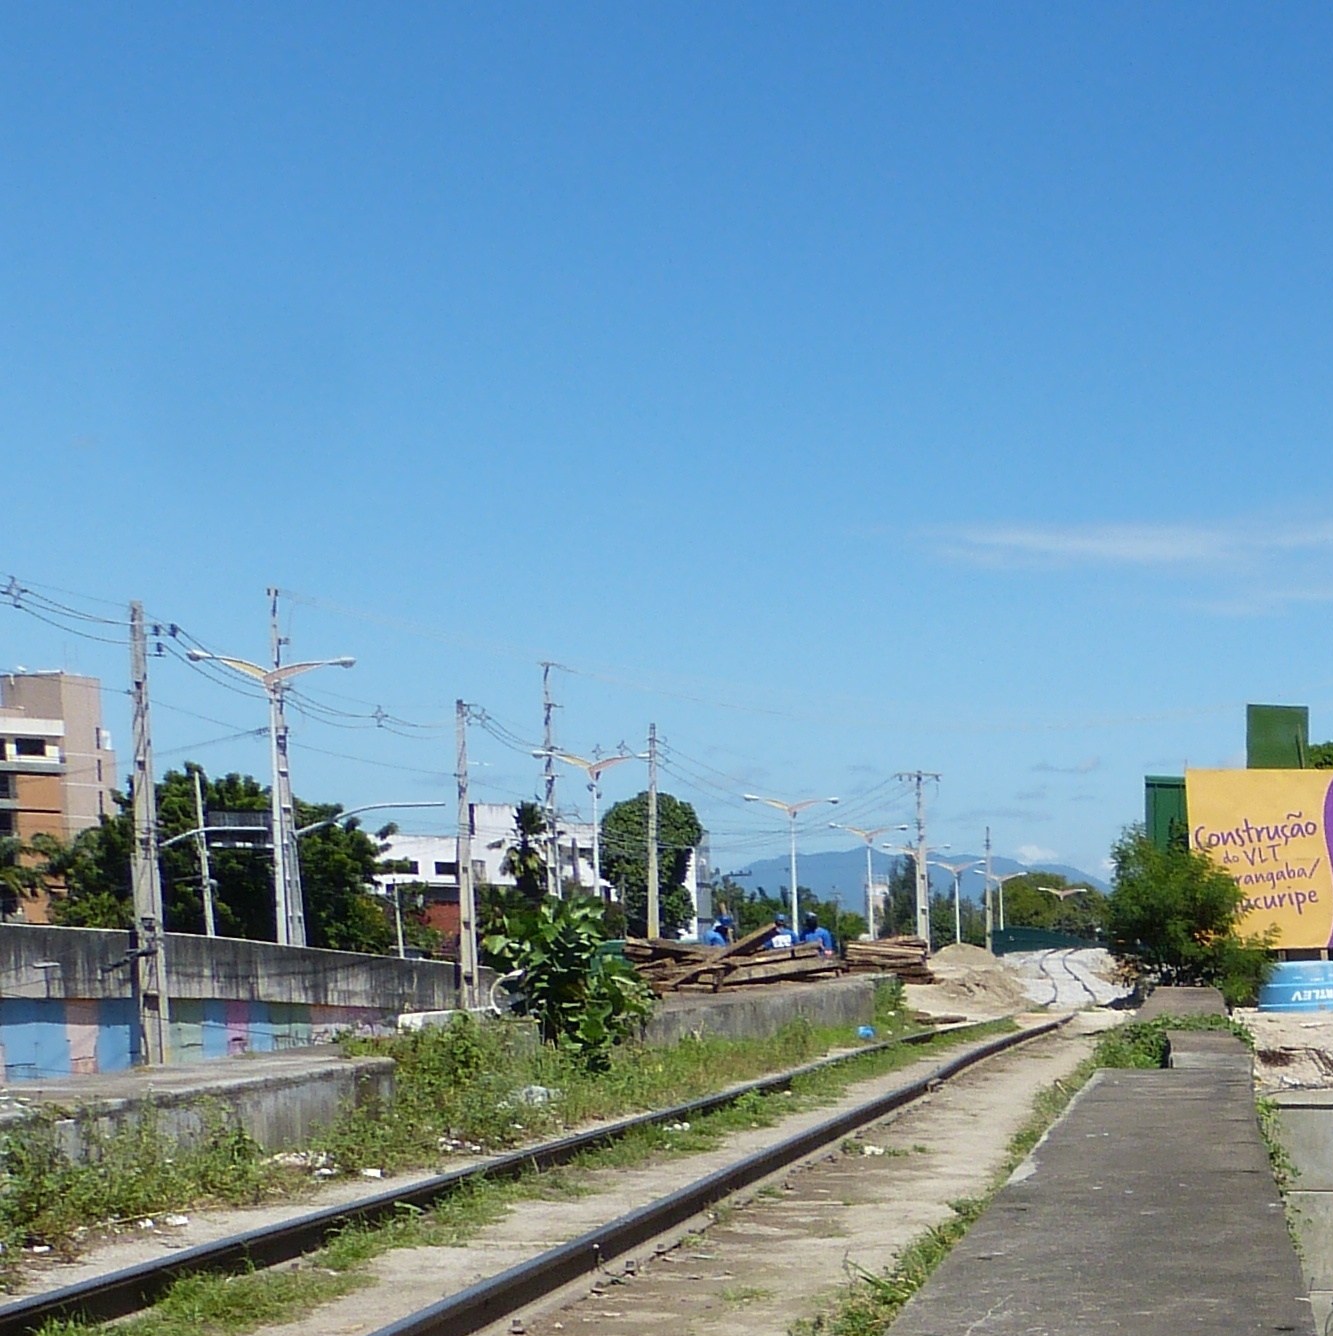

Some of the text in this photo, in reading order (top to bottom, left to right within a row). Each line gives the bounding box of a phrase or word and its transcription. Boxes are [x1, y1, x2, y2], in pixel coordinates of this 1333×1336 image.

[1194, 811, 1317, 853] Construção
[1222, 843, 1281, 866] do VLT
[1234, 858, 1320, 889] rangaba/
